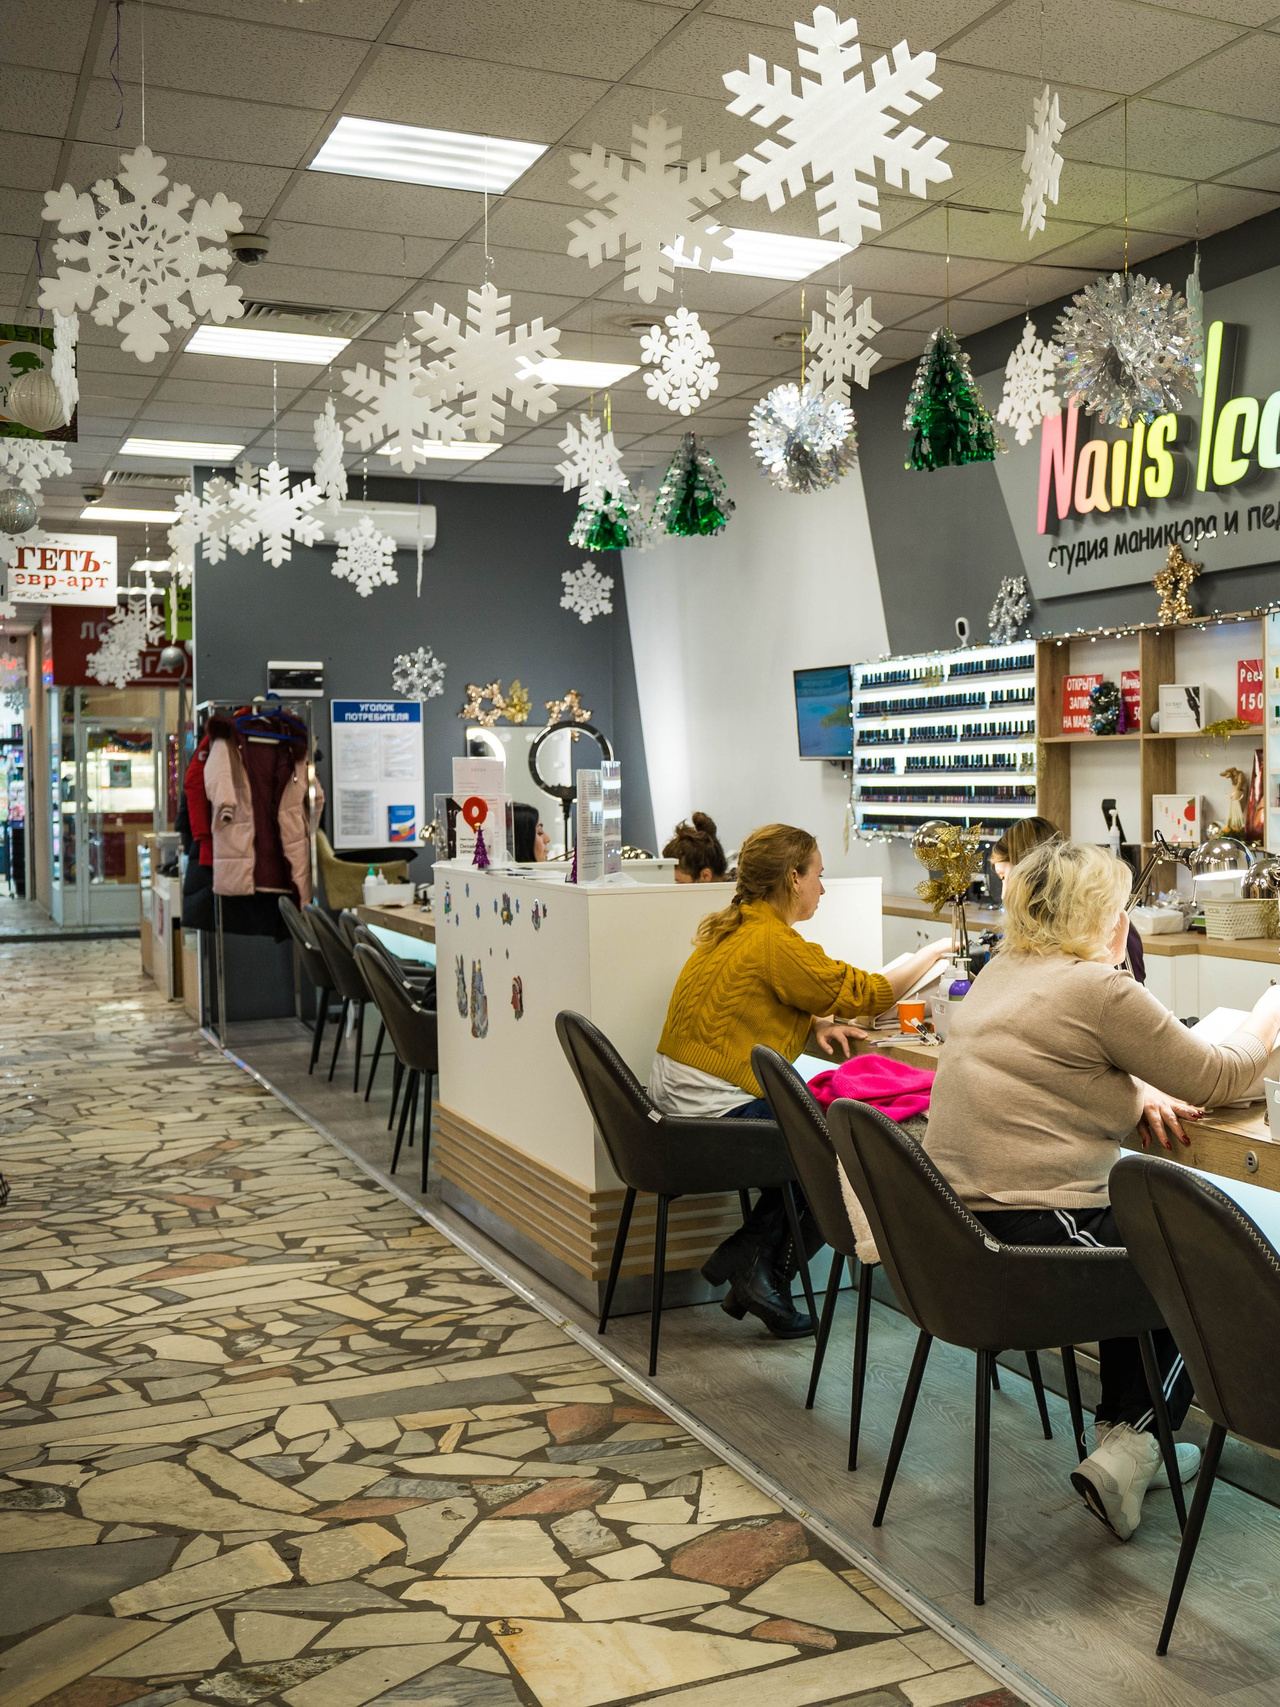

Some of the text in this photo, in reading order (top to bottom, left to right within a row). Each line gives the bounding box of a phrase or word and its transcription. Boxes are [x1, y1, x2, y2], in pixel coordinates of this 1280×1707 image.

[1037, 391, 1177, 535] Nails
[1049, 535, 1108, 575] студия
[1113, 514, 1217, 557] маникюра
[1224, 509, 1239, 536] и
[359, 703, 394, 712] УГОЛОК
[344, 712, 410, 722] ПОТРЕБИТЕЛЯ
[1063, 716, 1073, 729] НА
